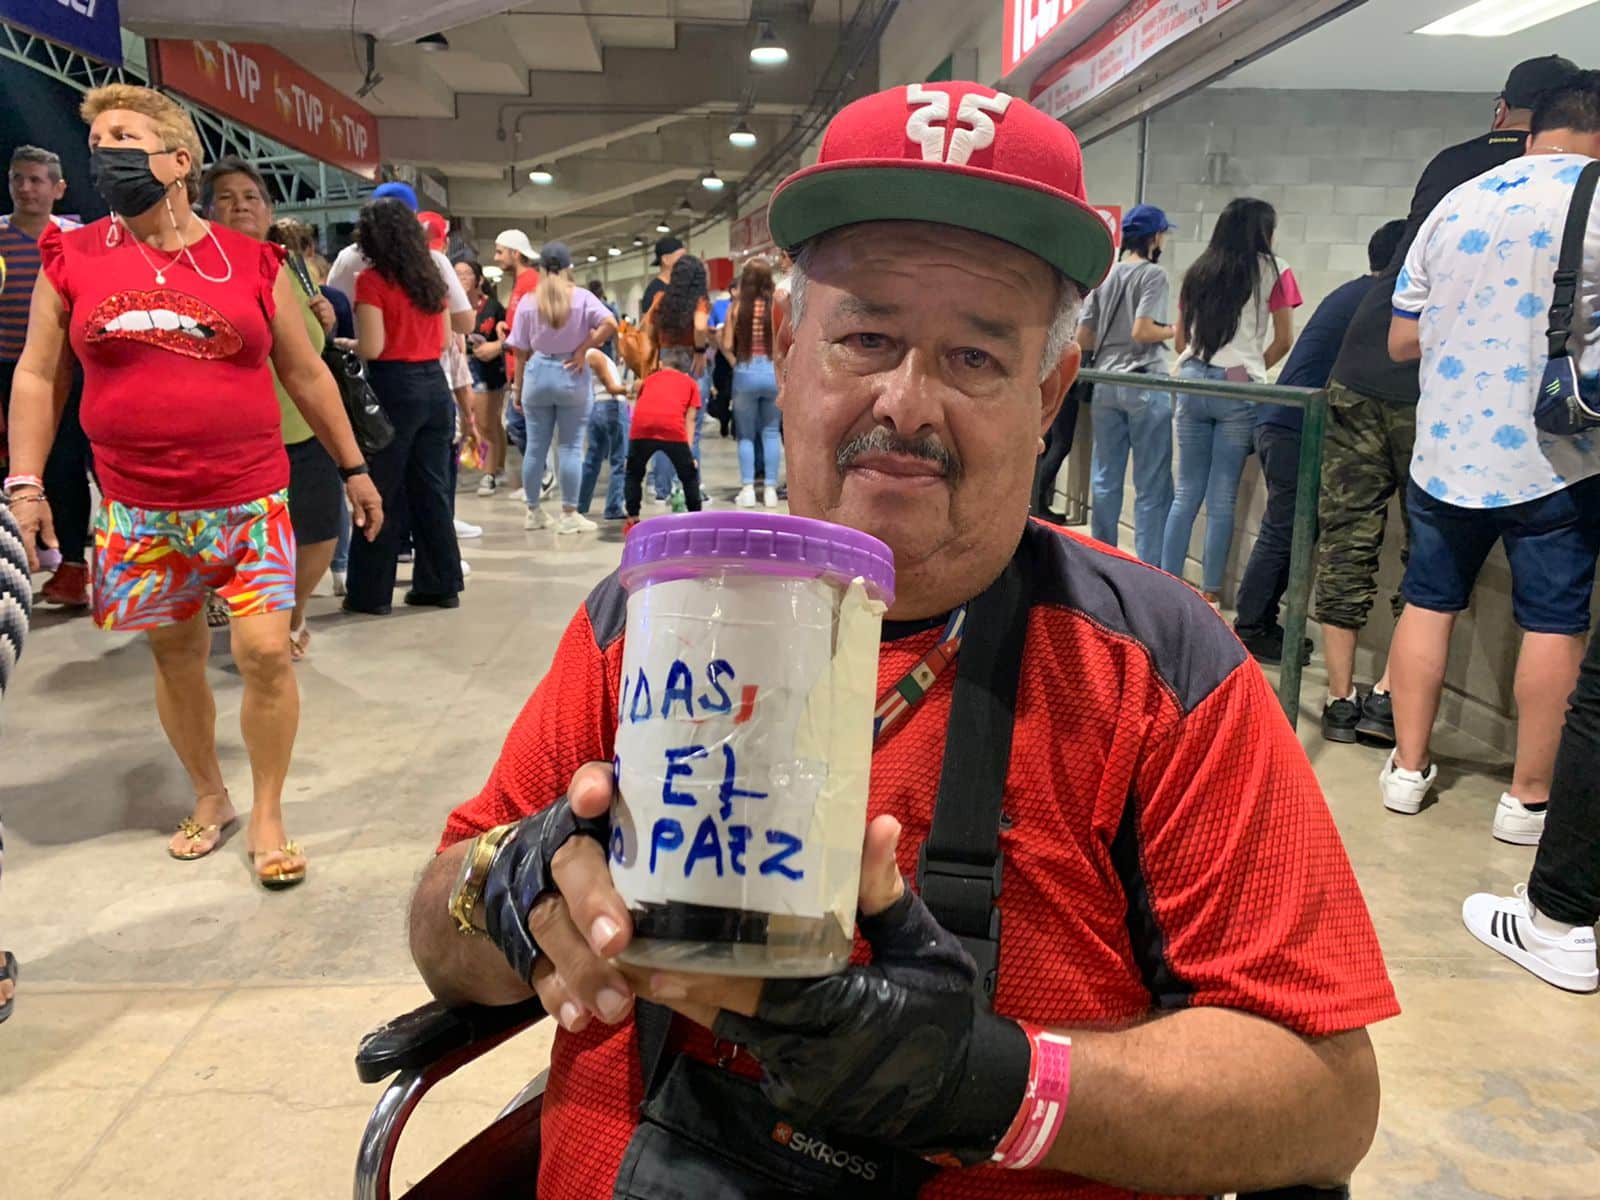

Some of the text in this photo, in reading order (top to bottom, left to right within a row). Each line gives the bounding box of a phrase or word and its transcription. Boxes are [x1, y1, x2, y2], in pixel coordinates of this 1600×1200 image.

[217, 40, 261, 104] TVP
[291, 84, 324, 135] TVP
[342, 114, 368, 159] TVP
[662, 743, 769, 815] EL
[789, 1132, 879, 1181] SKROSS
